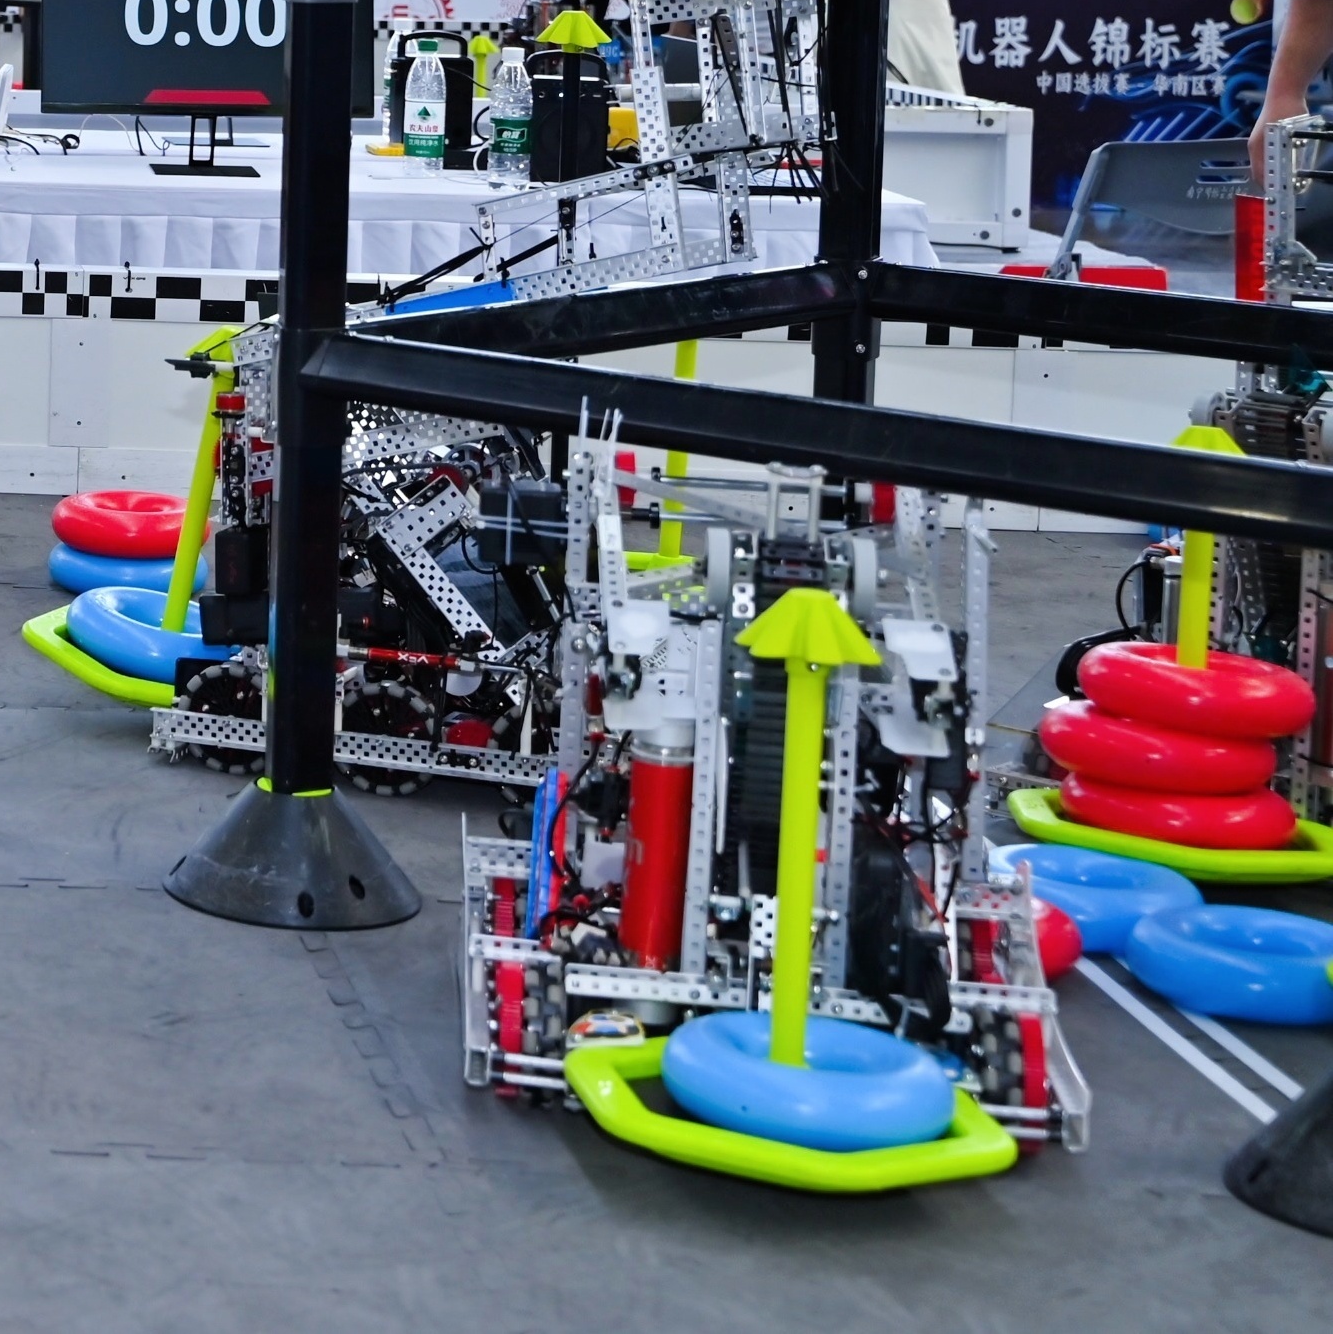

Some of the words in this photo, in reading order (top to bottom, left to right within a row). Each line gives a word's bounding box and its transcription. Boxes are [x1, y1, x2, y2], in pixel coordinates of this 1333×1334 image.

[1036, 70, 1130, 96] 中国选拔赛
